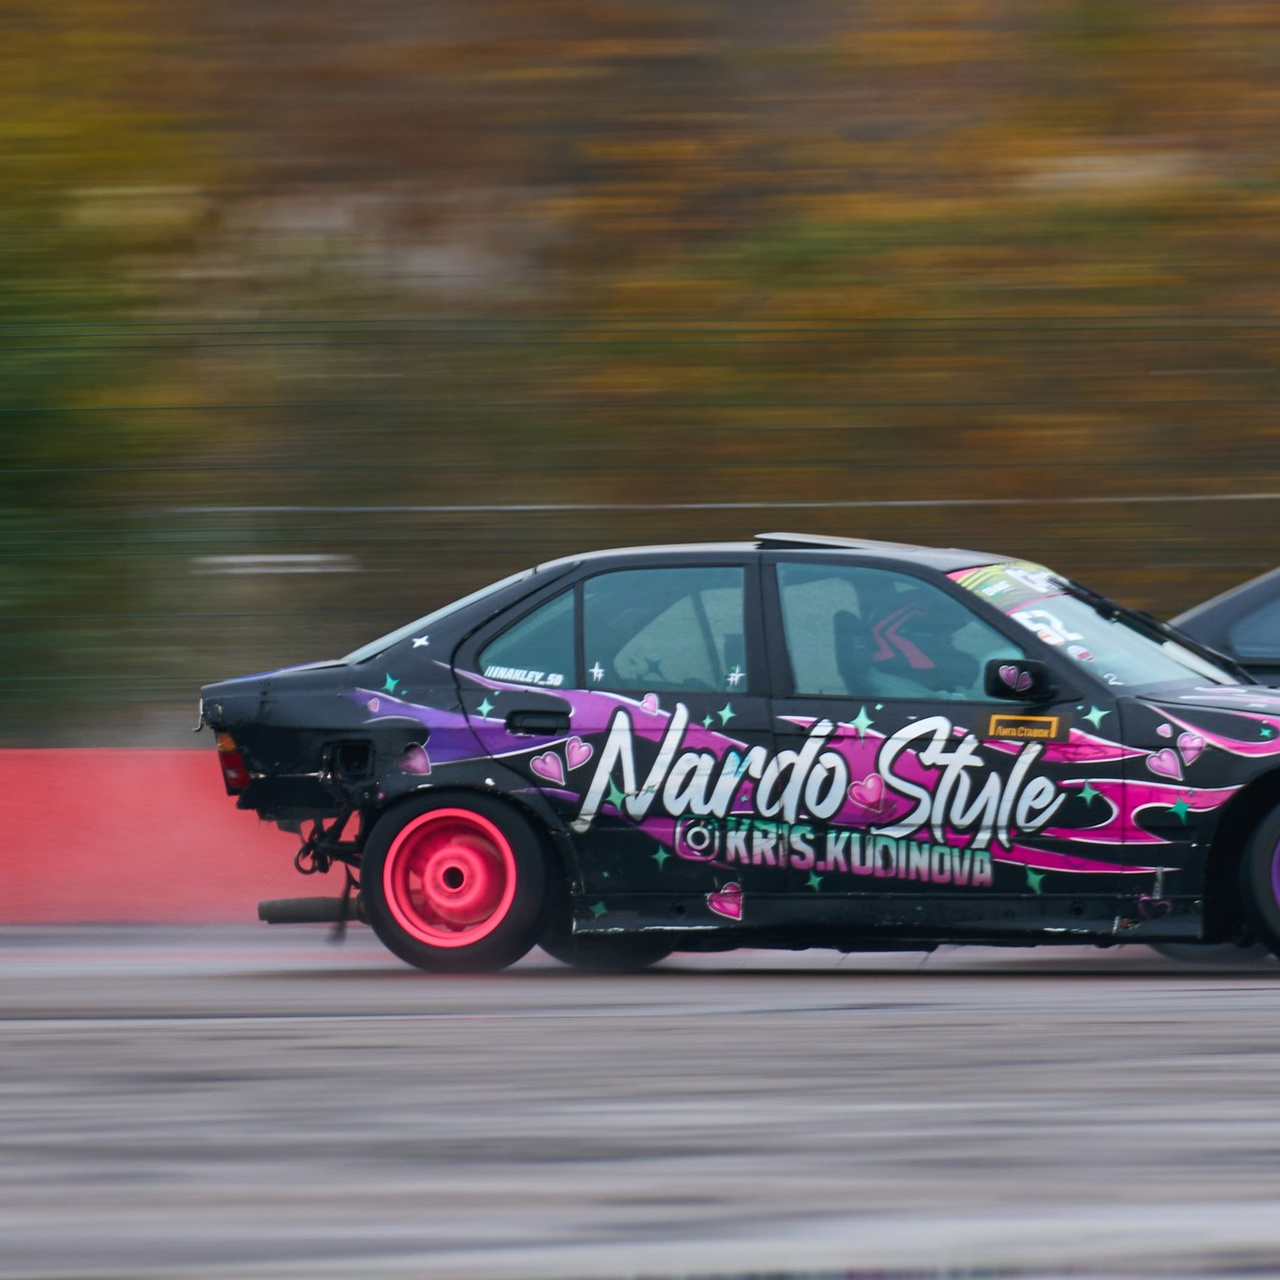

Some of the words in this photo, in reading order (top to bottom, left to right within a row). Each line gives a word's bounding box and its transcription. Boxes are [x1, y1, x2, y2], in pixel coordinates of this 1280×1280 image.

[570, 702, 848, 834] Nardo
[870, 715, 1067, 849] Style
[725, 816, 995, 887] KRIS.KUDINOVA
